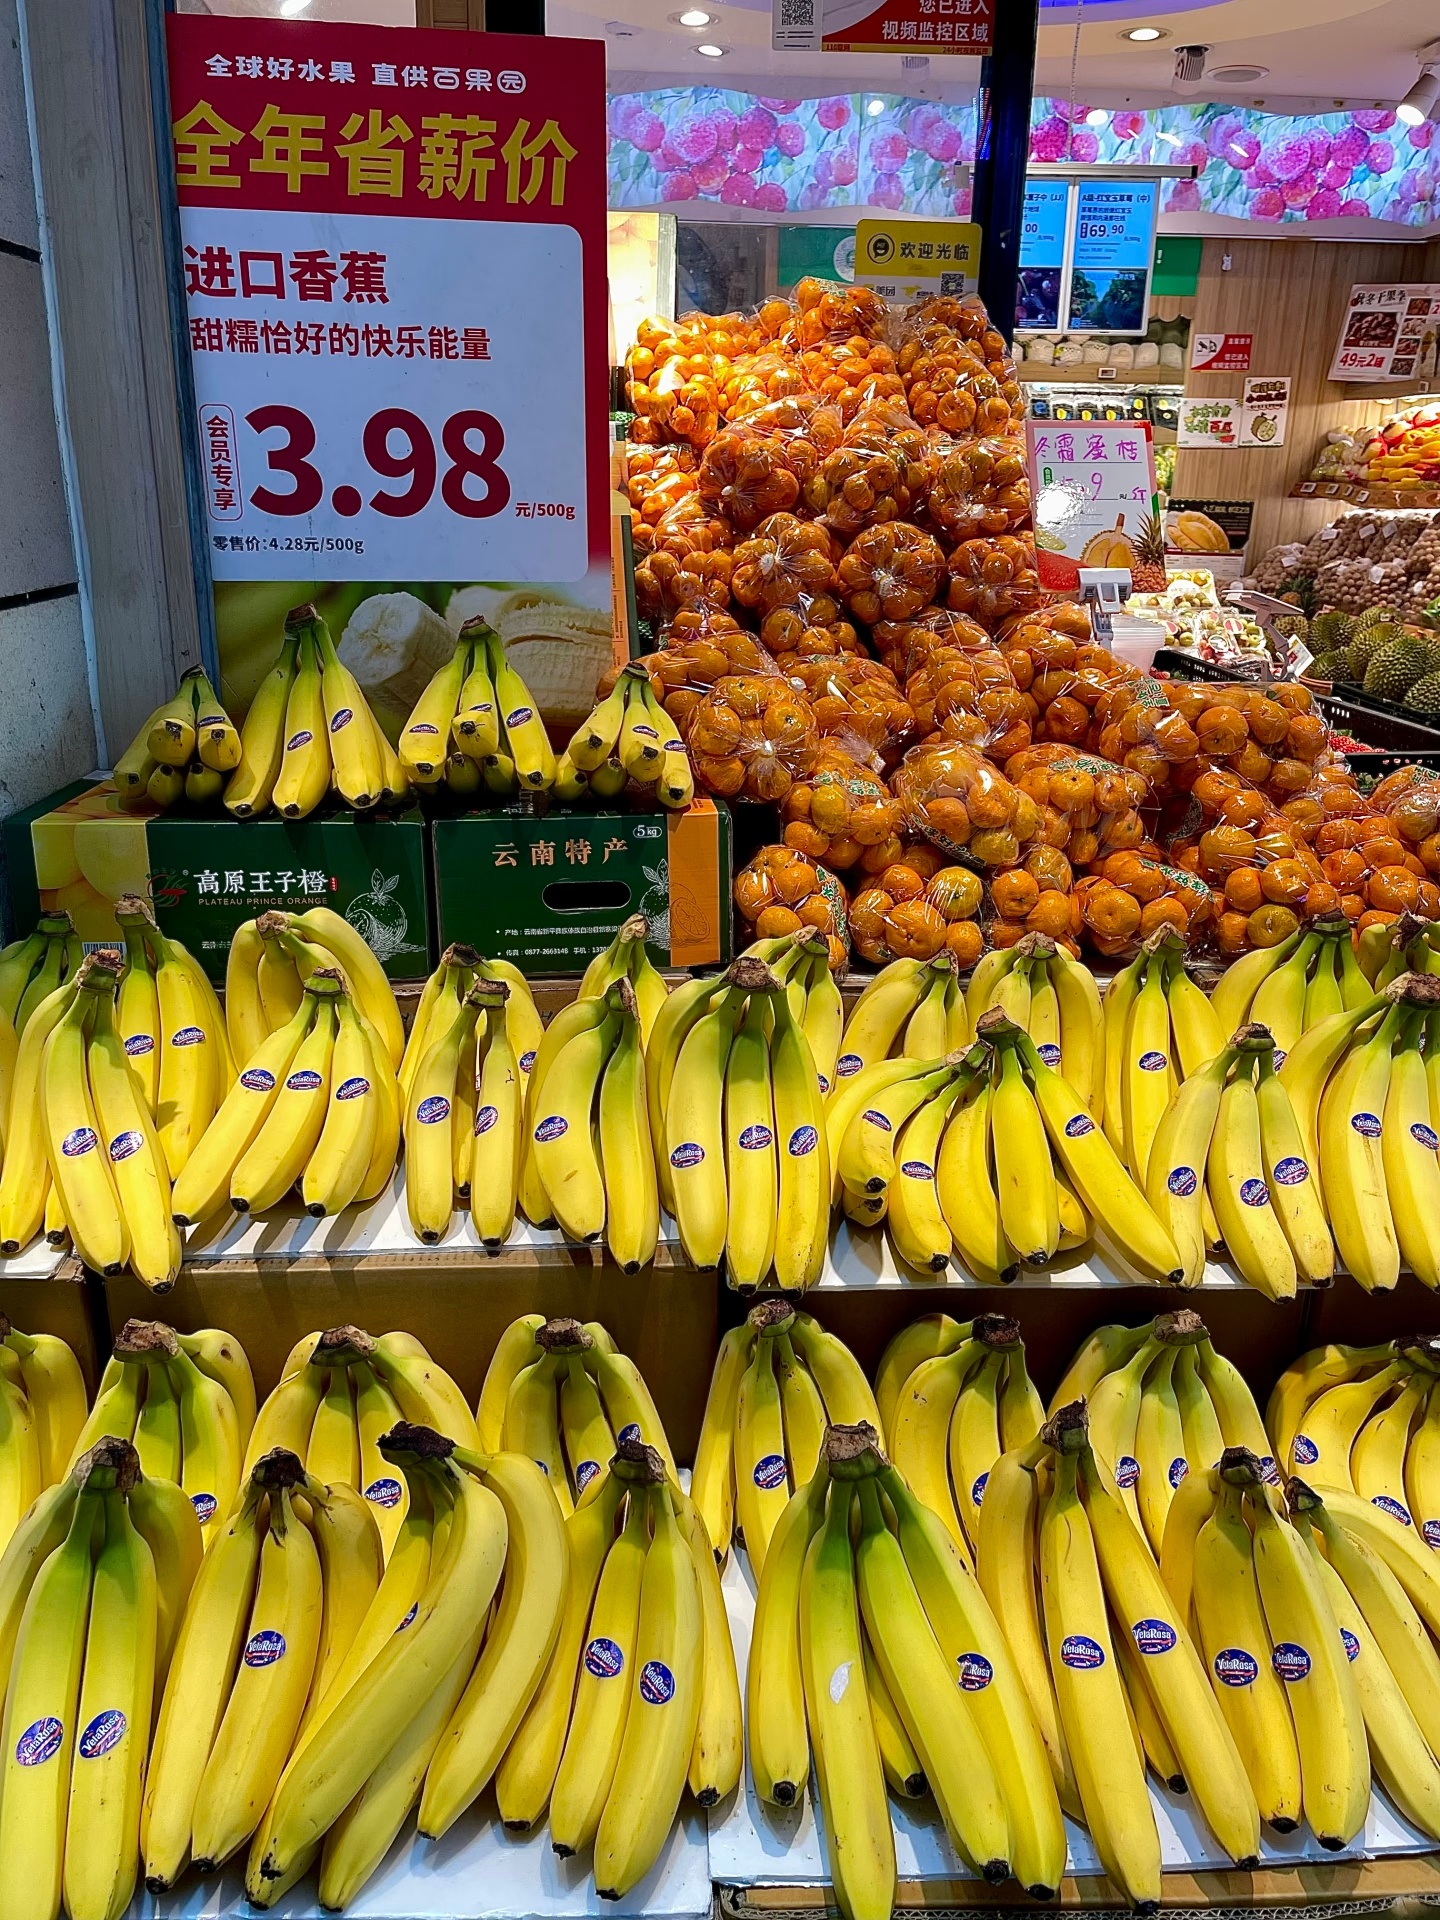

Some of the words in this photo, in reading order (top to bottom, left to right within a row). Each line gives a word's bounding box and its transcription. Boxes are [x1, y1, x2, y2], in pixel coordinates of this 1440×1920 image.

[919, 0, 990, 15] 您已进入
[882, 20, 989, 43] 视频监控区域
[204, 53, 356, 85] 全球好水果
[371, 62, 527, 94] 直供百果园
[172, 99, 579, 206] 全年省薪价
[900, 241, 970, 261] 欢迎光临
[183, 245, 391, 305] 进口香蕉
[190, 317, 492, 361] 甜糯恰好的快乐能量
[205, 415, 237, 511] 会员专享
[243, 404, 512, 519] 3.98
[515, 502, 576, 521] 元/500g
[491, 837, 629, 867] 云南特产
[193, 868, 329, 895] 高原王子橙
[198, 897, 243, 906] PLATEAU
[246, 897, 283, 906] PRINCE
[287, 897, 328, 905] ORANGE
[249, 1640, 282, 1653] VelaRosa
[591, 1641, 620, 1671] VelaRosa
[1063, 1643, 1101, 1658] VelaRosa
[1216, 1658, 1255, 1671] VelaRosa
[645, 1663, 670, 1698] VelaRosa
[22, 1720, 58, 1760] VelaRosa
[83, 1714, 121, 1752] VelaRosa
